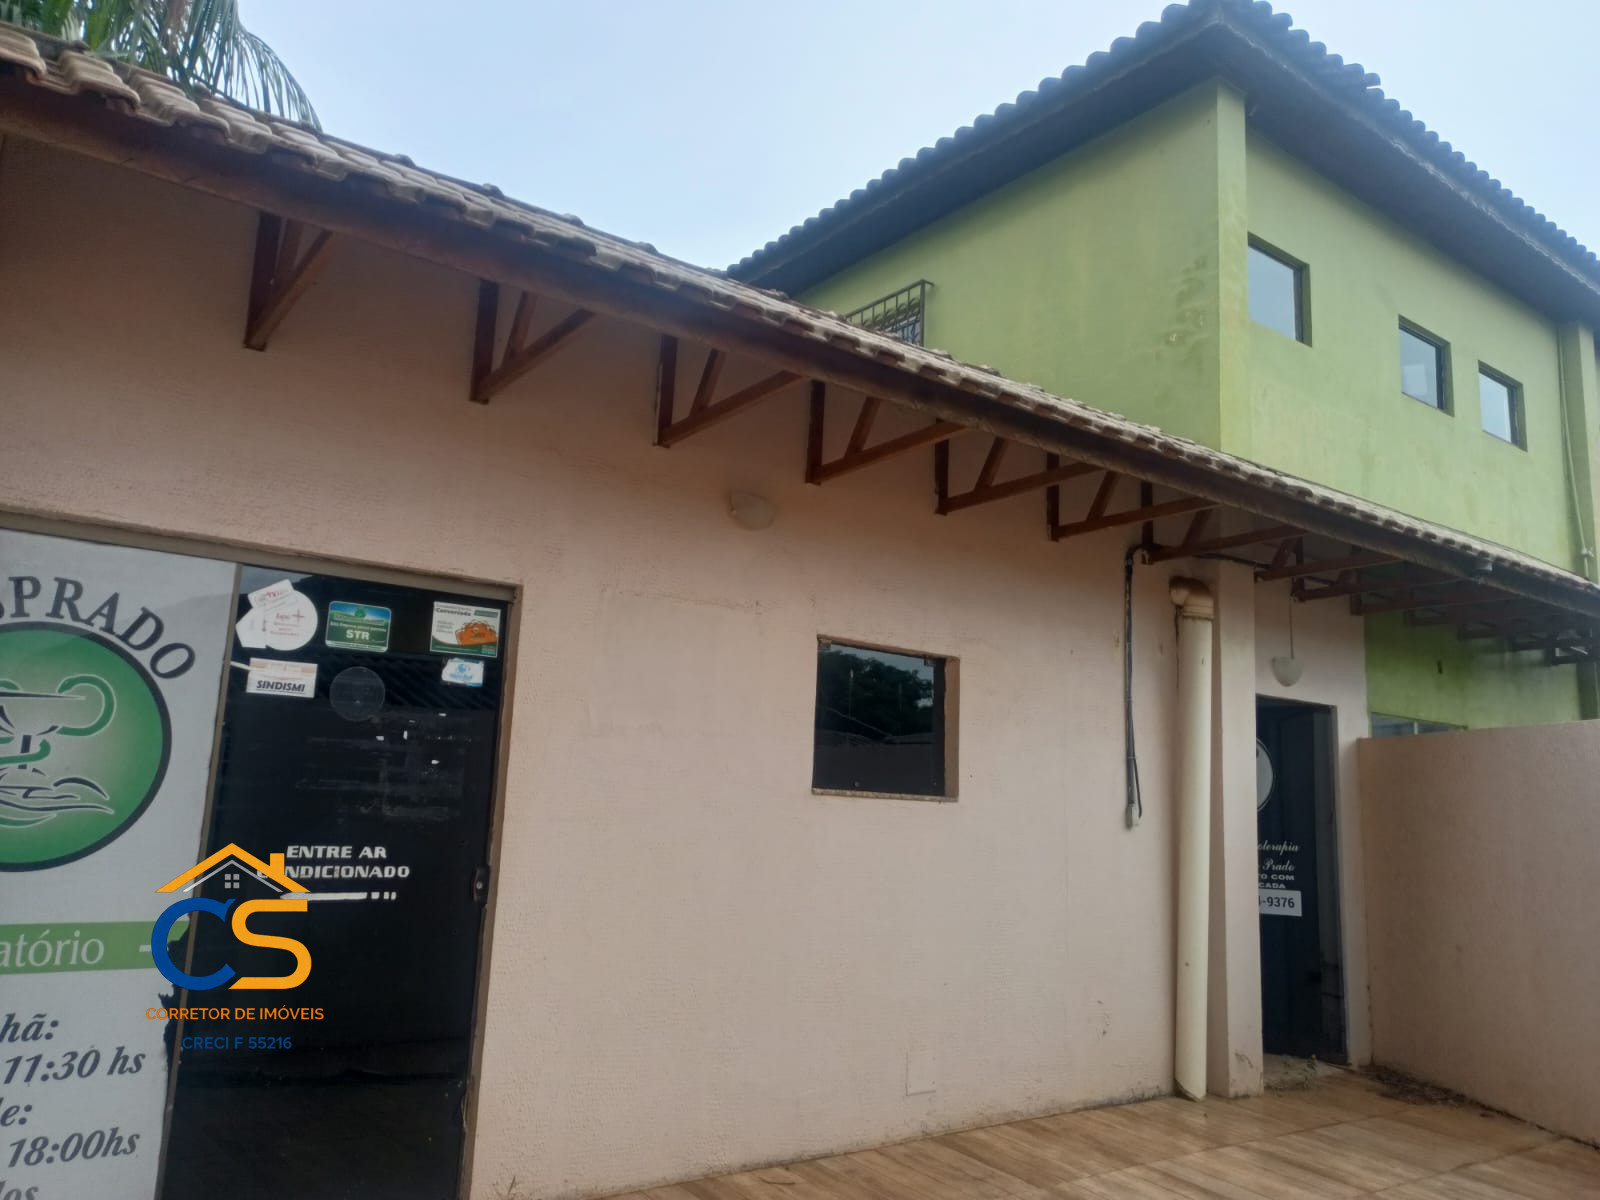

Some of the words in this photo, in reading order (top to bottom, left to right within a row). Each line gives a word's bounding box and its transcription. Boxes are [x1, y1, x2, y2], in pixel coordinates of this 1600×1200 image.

[0, 576, 195, 678] PRADO
[345, 629, 370, 641] STR
[256, 680, 306, 693] SINDISMI
[286, 845, 352, 859] ENTRE
[358, 846, 387, 859] AR
[256, 865, 410, 879] NDICIONADO
[3, 1049, 101, 1085] 11:30
[106, 1045, 146, 1076] hs
[0, 1097, 33, 1127] e:
[8, 1126, 140, 1168] 18:00hs
